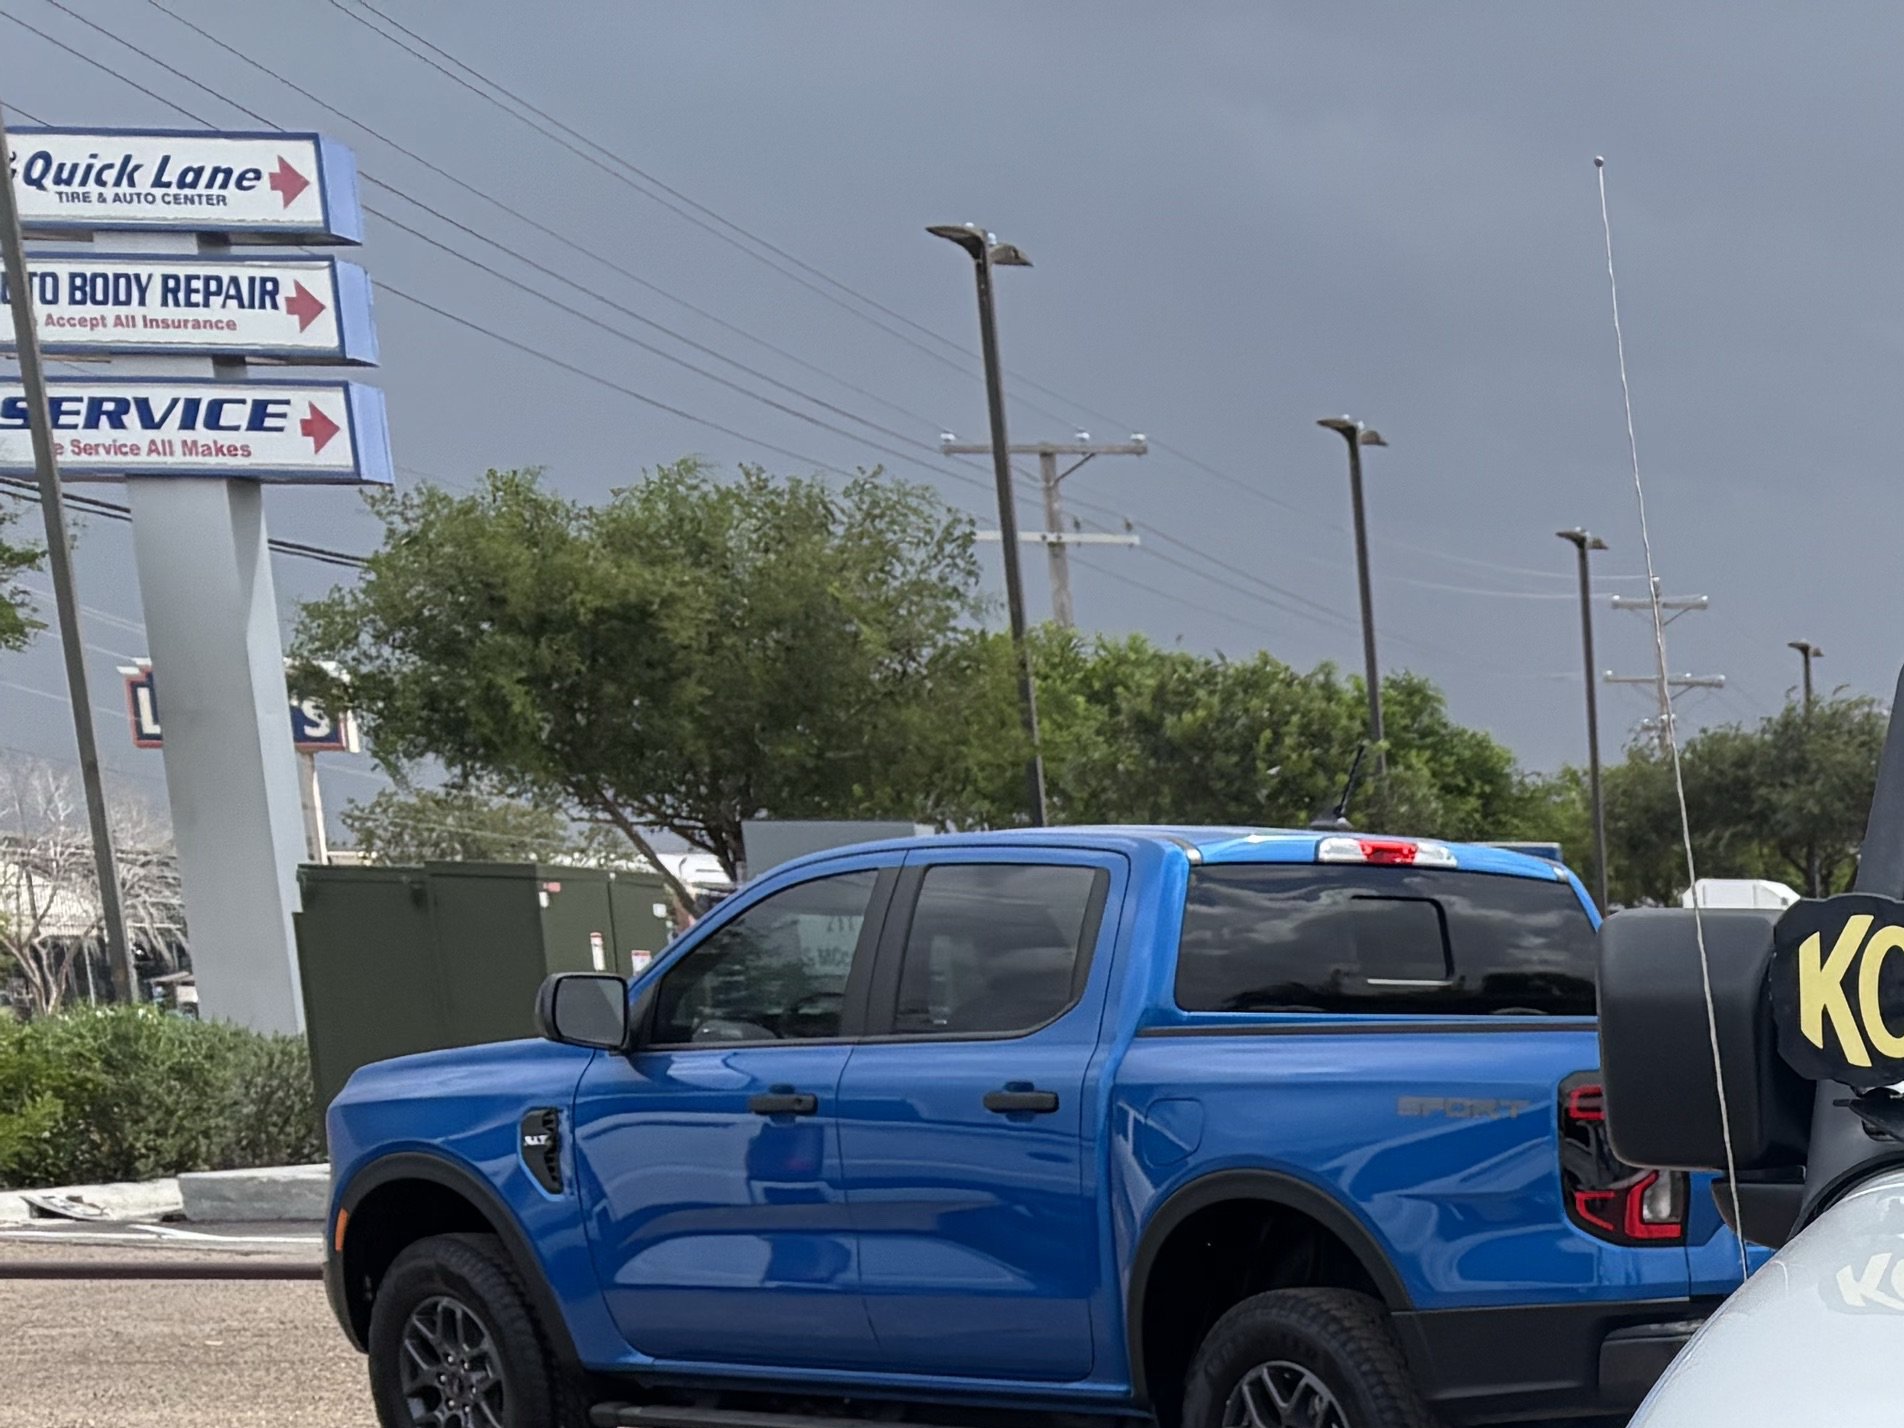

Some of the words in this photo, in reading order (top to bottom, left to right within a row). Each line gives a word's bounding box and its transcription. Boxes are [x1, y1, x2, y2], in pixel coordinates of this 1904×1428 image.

[22, 150, 144, 192] Quick
[150, 154, 262, 191] Lane
[55, 190, 92, 204] TIRE
[97, 191, 107, 204] &
[112, 192, 156, 205] AUTO
[161, 192, 227, 206] CENTER
[0, 271, 59, 305] TO
[68, 271, 153, 307] BODY
[160, 273, 280, 311] REPAIR
[44, 313, 107, 331] Accept
[113, 314, 137, 329] All
[142, 314, 237, 331] Insurance
[0, 395, 291, 432] SERVICE
[70, 438, 141, 457] Service
[146, 438, 174, 457] All
[181, 439, 252, 458] Makes
